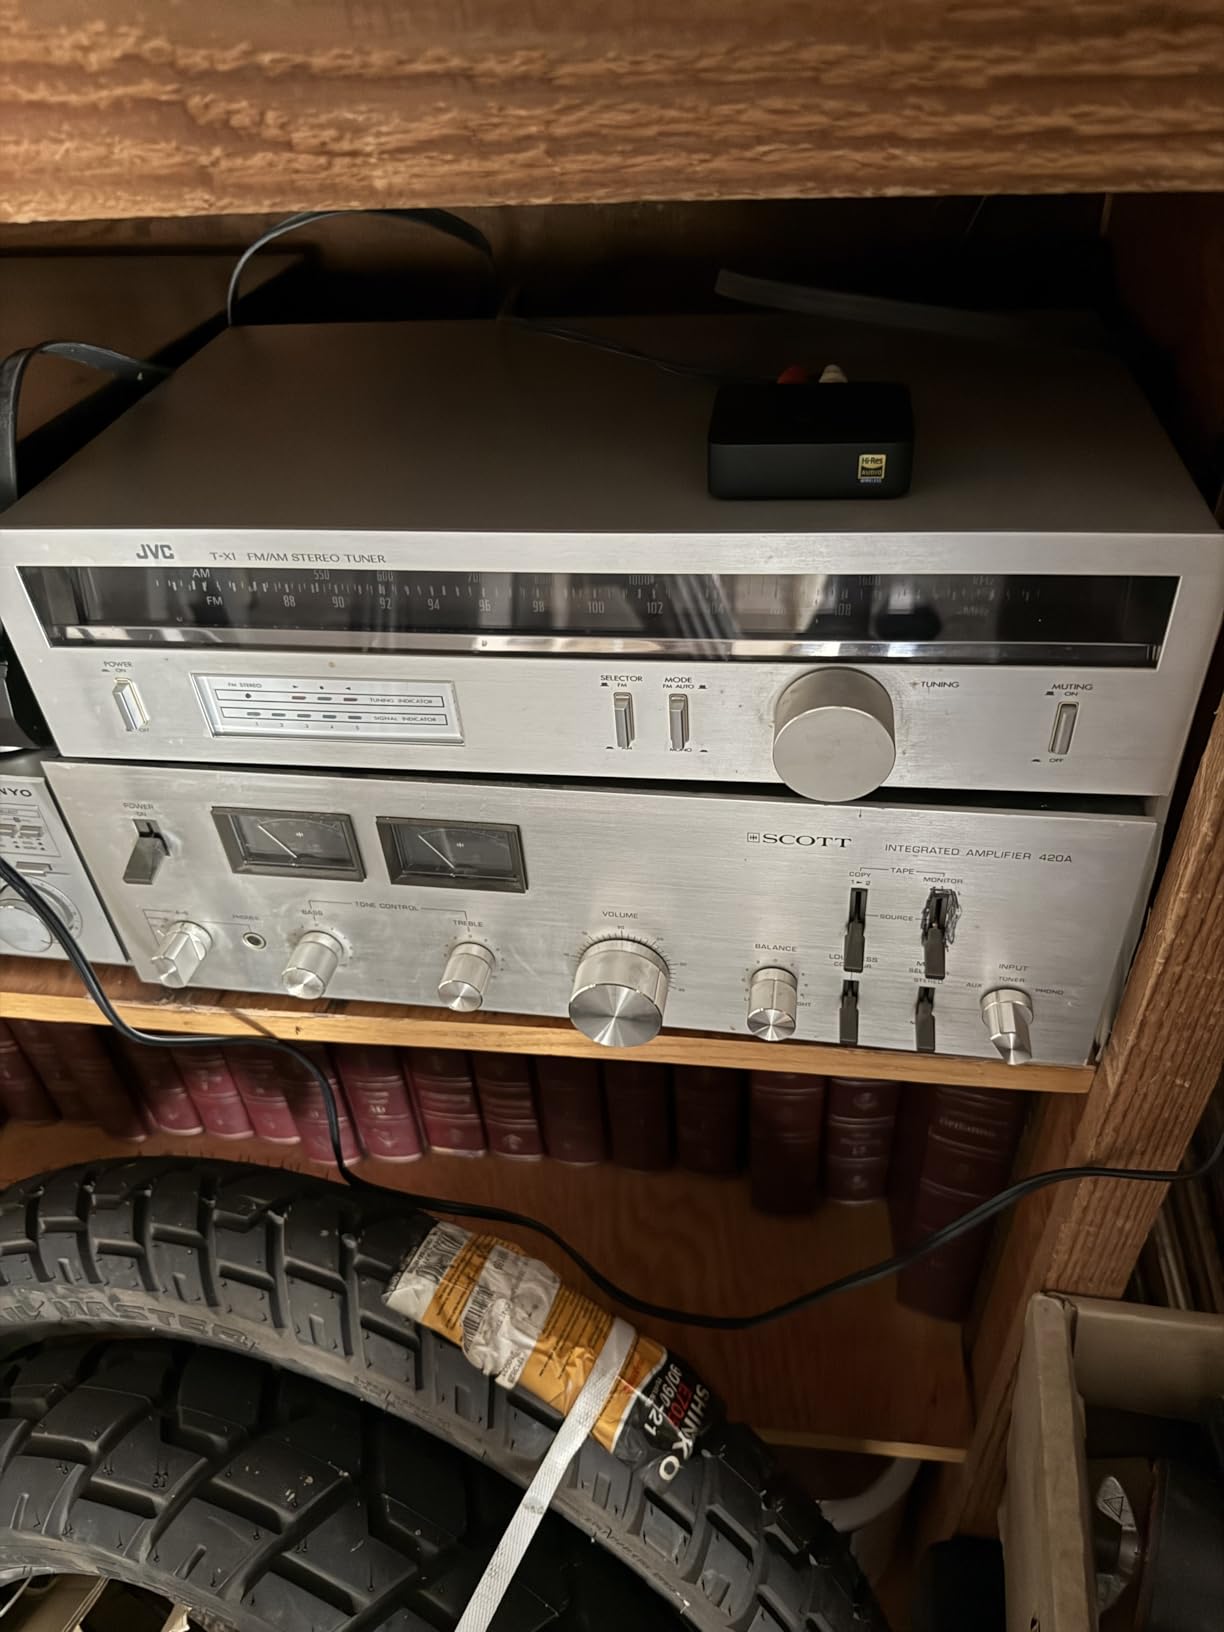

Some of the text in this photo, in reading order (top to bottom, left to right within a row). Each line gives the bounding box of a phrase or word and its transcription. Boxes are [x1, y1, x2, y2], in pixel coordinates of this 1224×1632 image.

[136, 544, 174, 560] JVC
[247, 552, 288, 562] FM/AM
[291, 553, 340, 563] STEREO
[344, 554, 386, 564] TUNER
[192, 569, 211, 578] AM
[206, 596, 223, 605] FM
[283, 595, 296, 608] 88
[331, 596, 345, 609] 90
[379, 597, 393, 610] 92
[427, 598, 440, 611] 94
[479, 599, 491, 613] 96
[532, 600, 545, 613] 98
[588, 601, 605, 614] 100
[647, 602, 664, 615] 102
[600, 674, 643, 683] SELECTOR
[664, 676, 693, 684] MODE
[920, 681, 960, 689] TUNING
[1051, 683, 1093, 691] MUTING
[762, 833, 852, 848] SCOTT
[884, 843, 1073, 863] INTEGRATED AMPLIFIER 420A
[890, 867, 915, 875] TAPE
[923, 876, 963, 885] MONITOR
[378, 902, 419, 912] CONTROL
[602, 911, 639, 919] VOLUME
[879, 913, 914, 922] SOURCE
[453, 919, 484, 928] TREBLE
[754, 943, 798, 953] BALANCE
[998, 963, 1029, 972] INPUT
[658, 1383, 711, 1482] SHINKO
